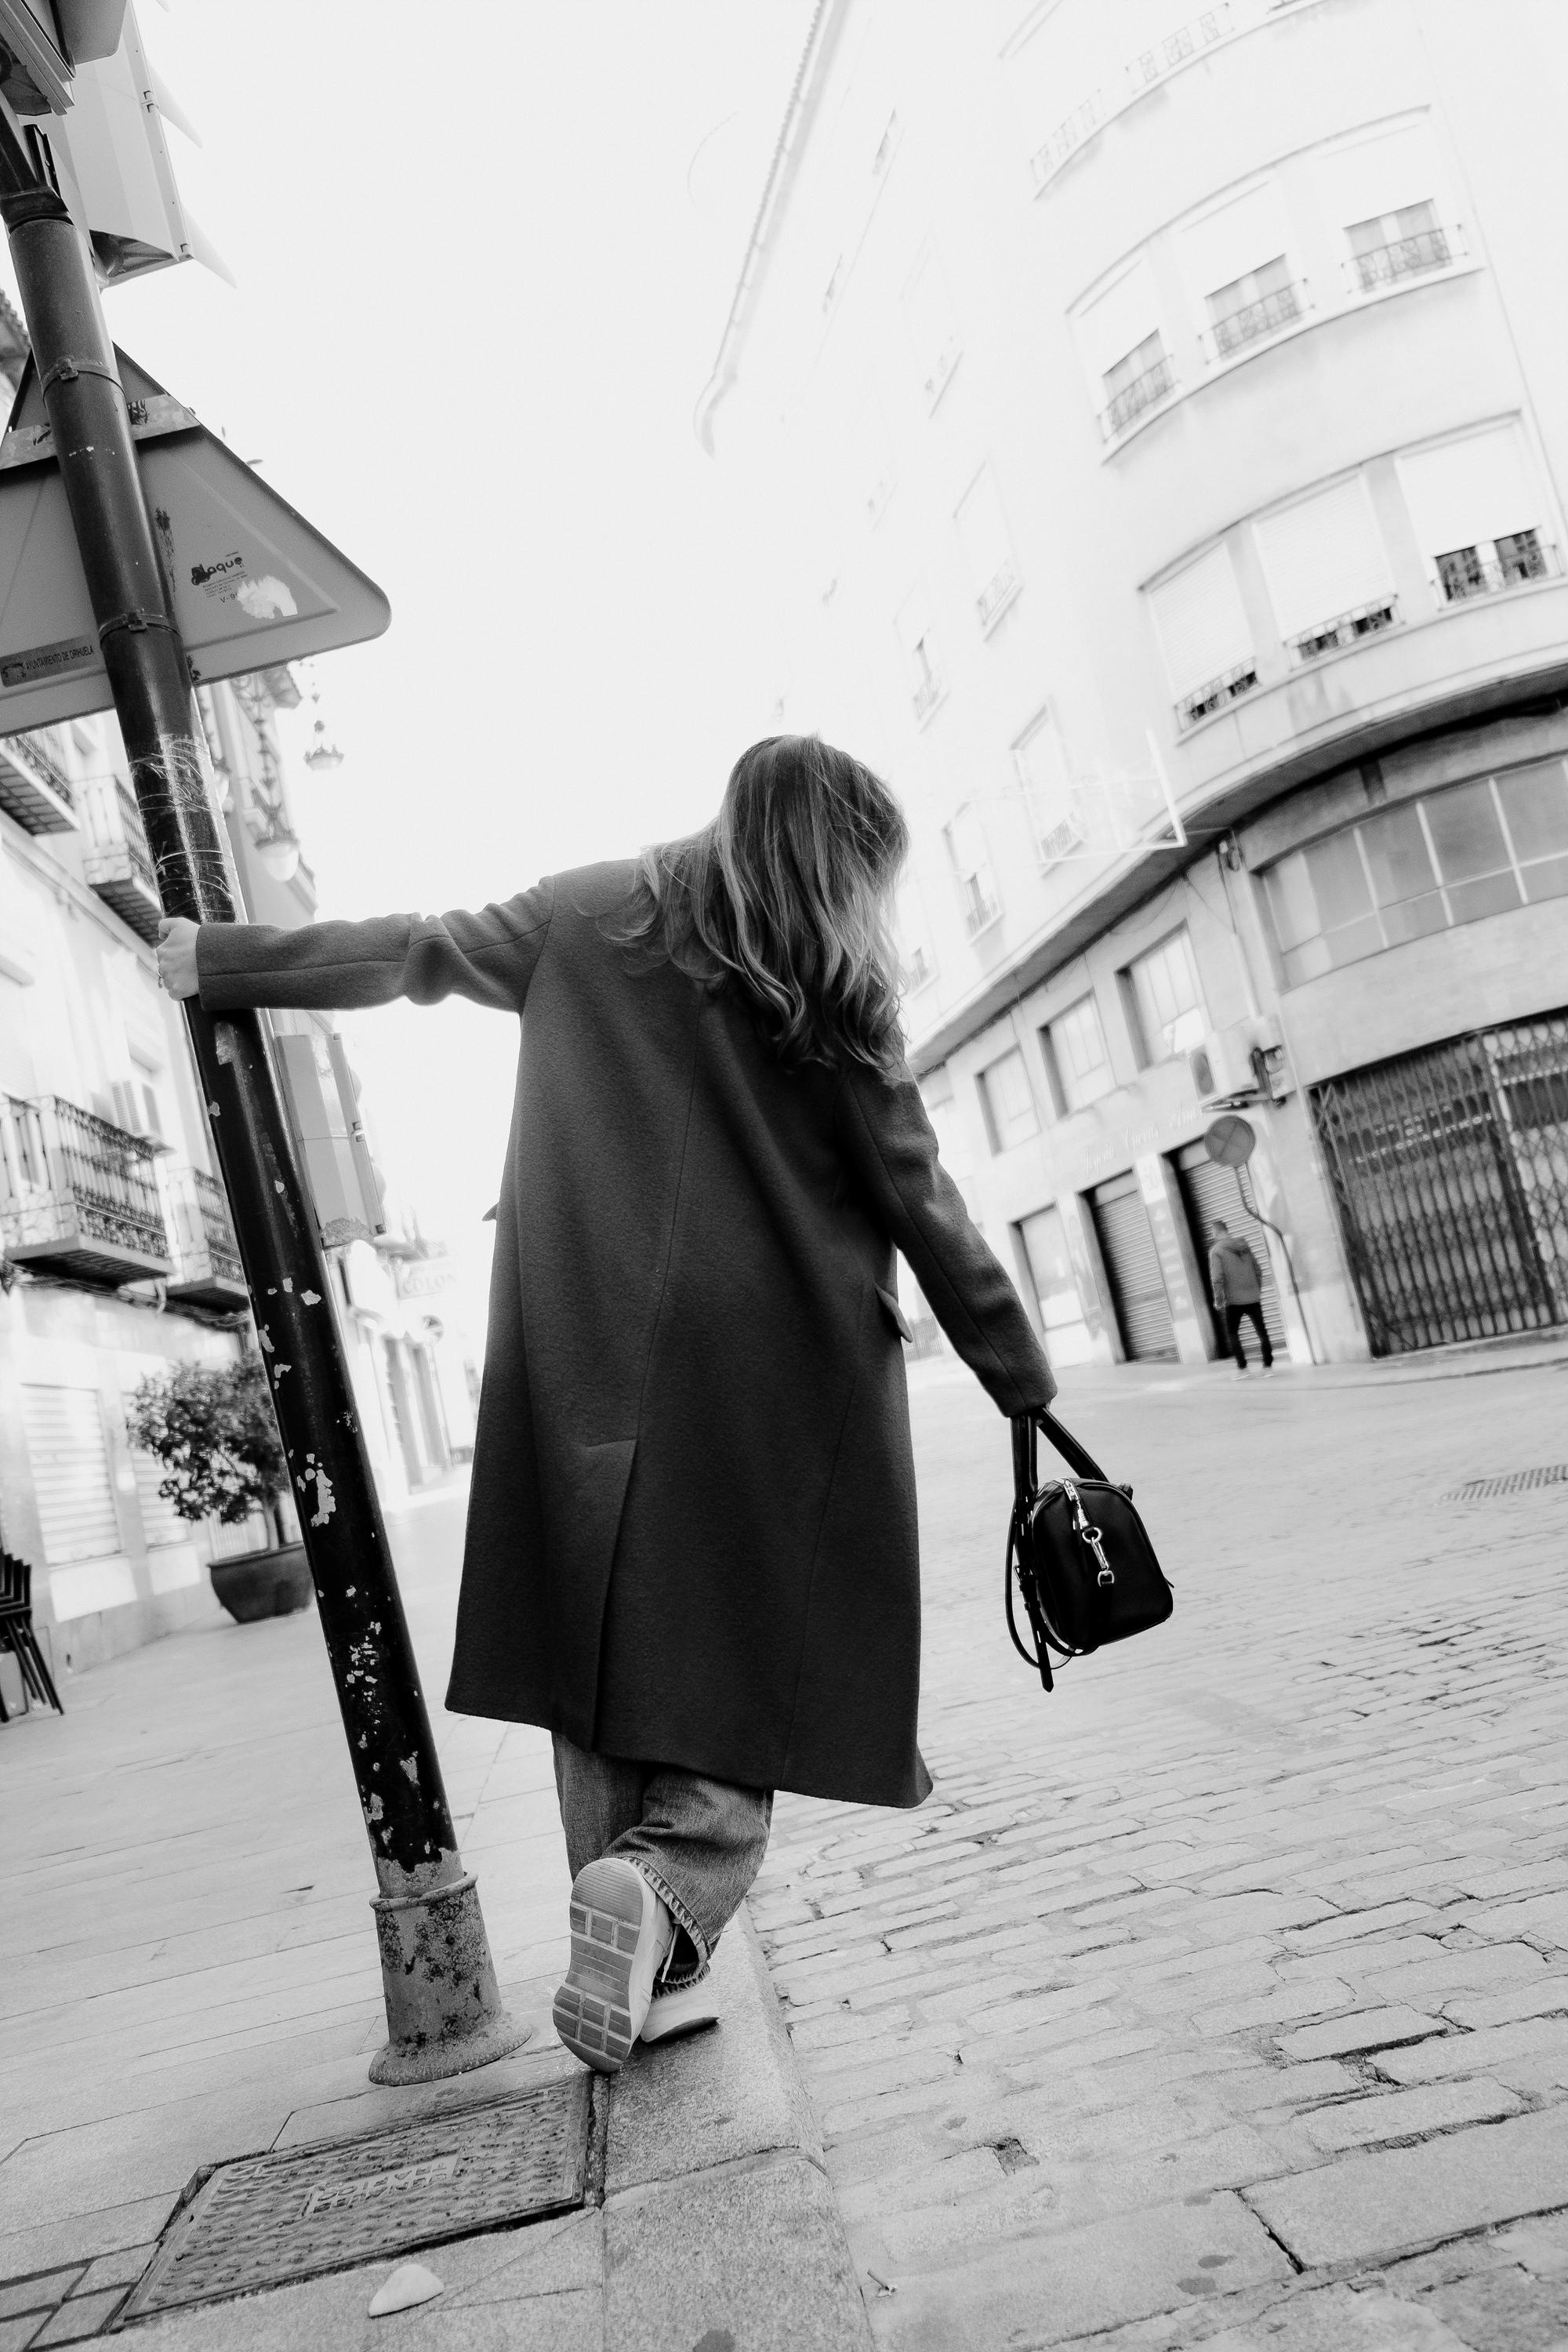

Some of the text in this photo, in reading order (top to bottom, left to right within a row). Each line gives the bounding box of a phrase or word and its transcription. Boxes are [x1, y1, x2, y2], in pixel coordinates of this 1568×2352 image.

[25, 644, 94, 670] AYUNTAMIENTO DE ORIHUELA
